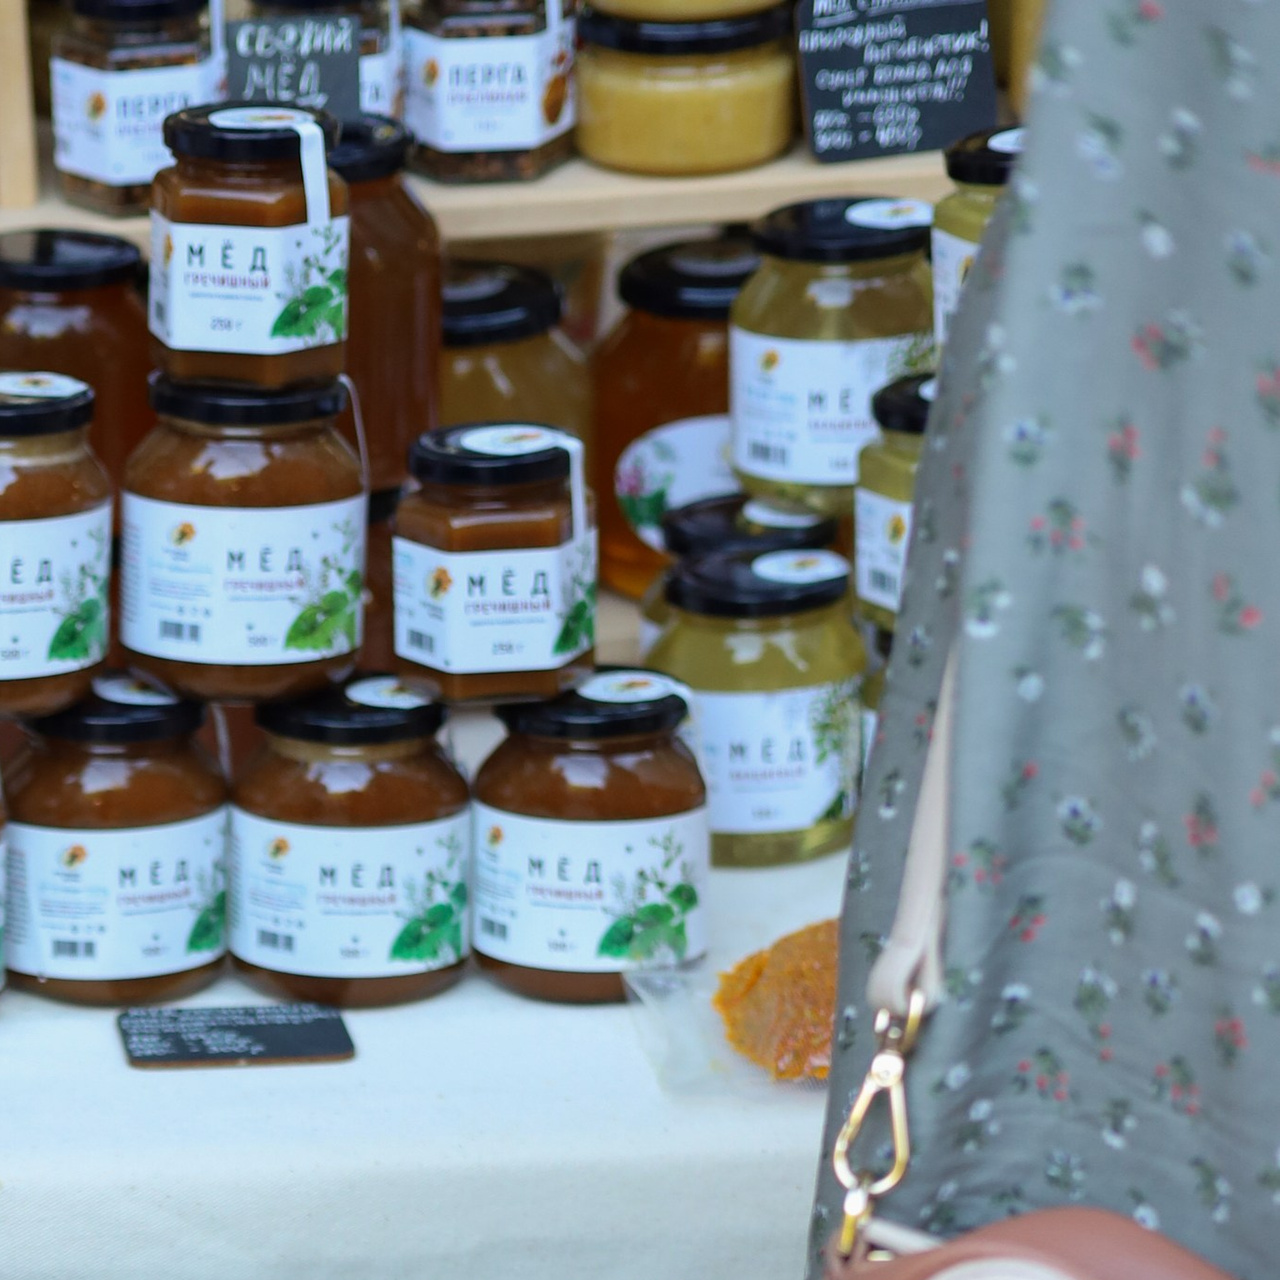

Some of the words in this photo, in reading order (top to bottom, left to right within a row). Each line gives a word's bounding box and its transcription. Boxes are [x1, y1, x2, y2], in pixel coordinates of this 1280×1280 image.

[241, 55, 328, 108] МЁД
[449, 63, 528, 86] ПЕРГА
[187, 240, 268, 272] МЁД
[184, 273, 270, 288] ГРЕЧИШНЫЙ
[808, 389, 851, 413] МЁ
[227, 544, 302, 572] МЁД
[467, 569, 549, 597] МЁД
[465, 600, 550, 615] ГРЕЧИШНЫЙ
[728, 738, 806, 763] МЁД
[118, 859, 188, 887] МЁД
[319, 862, 395, 888] МЁД
[527, 857, 601, 884] МЁД
